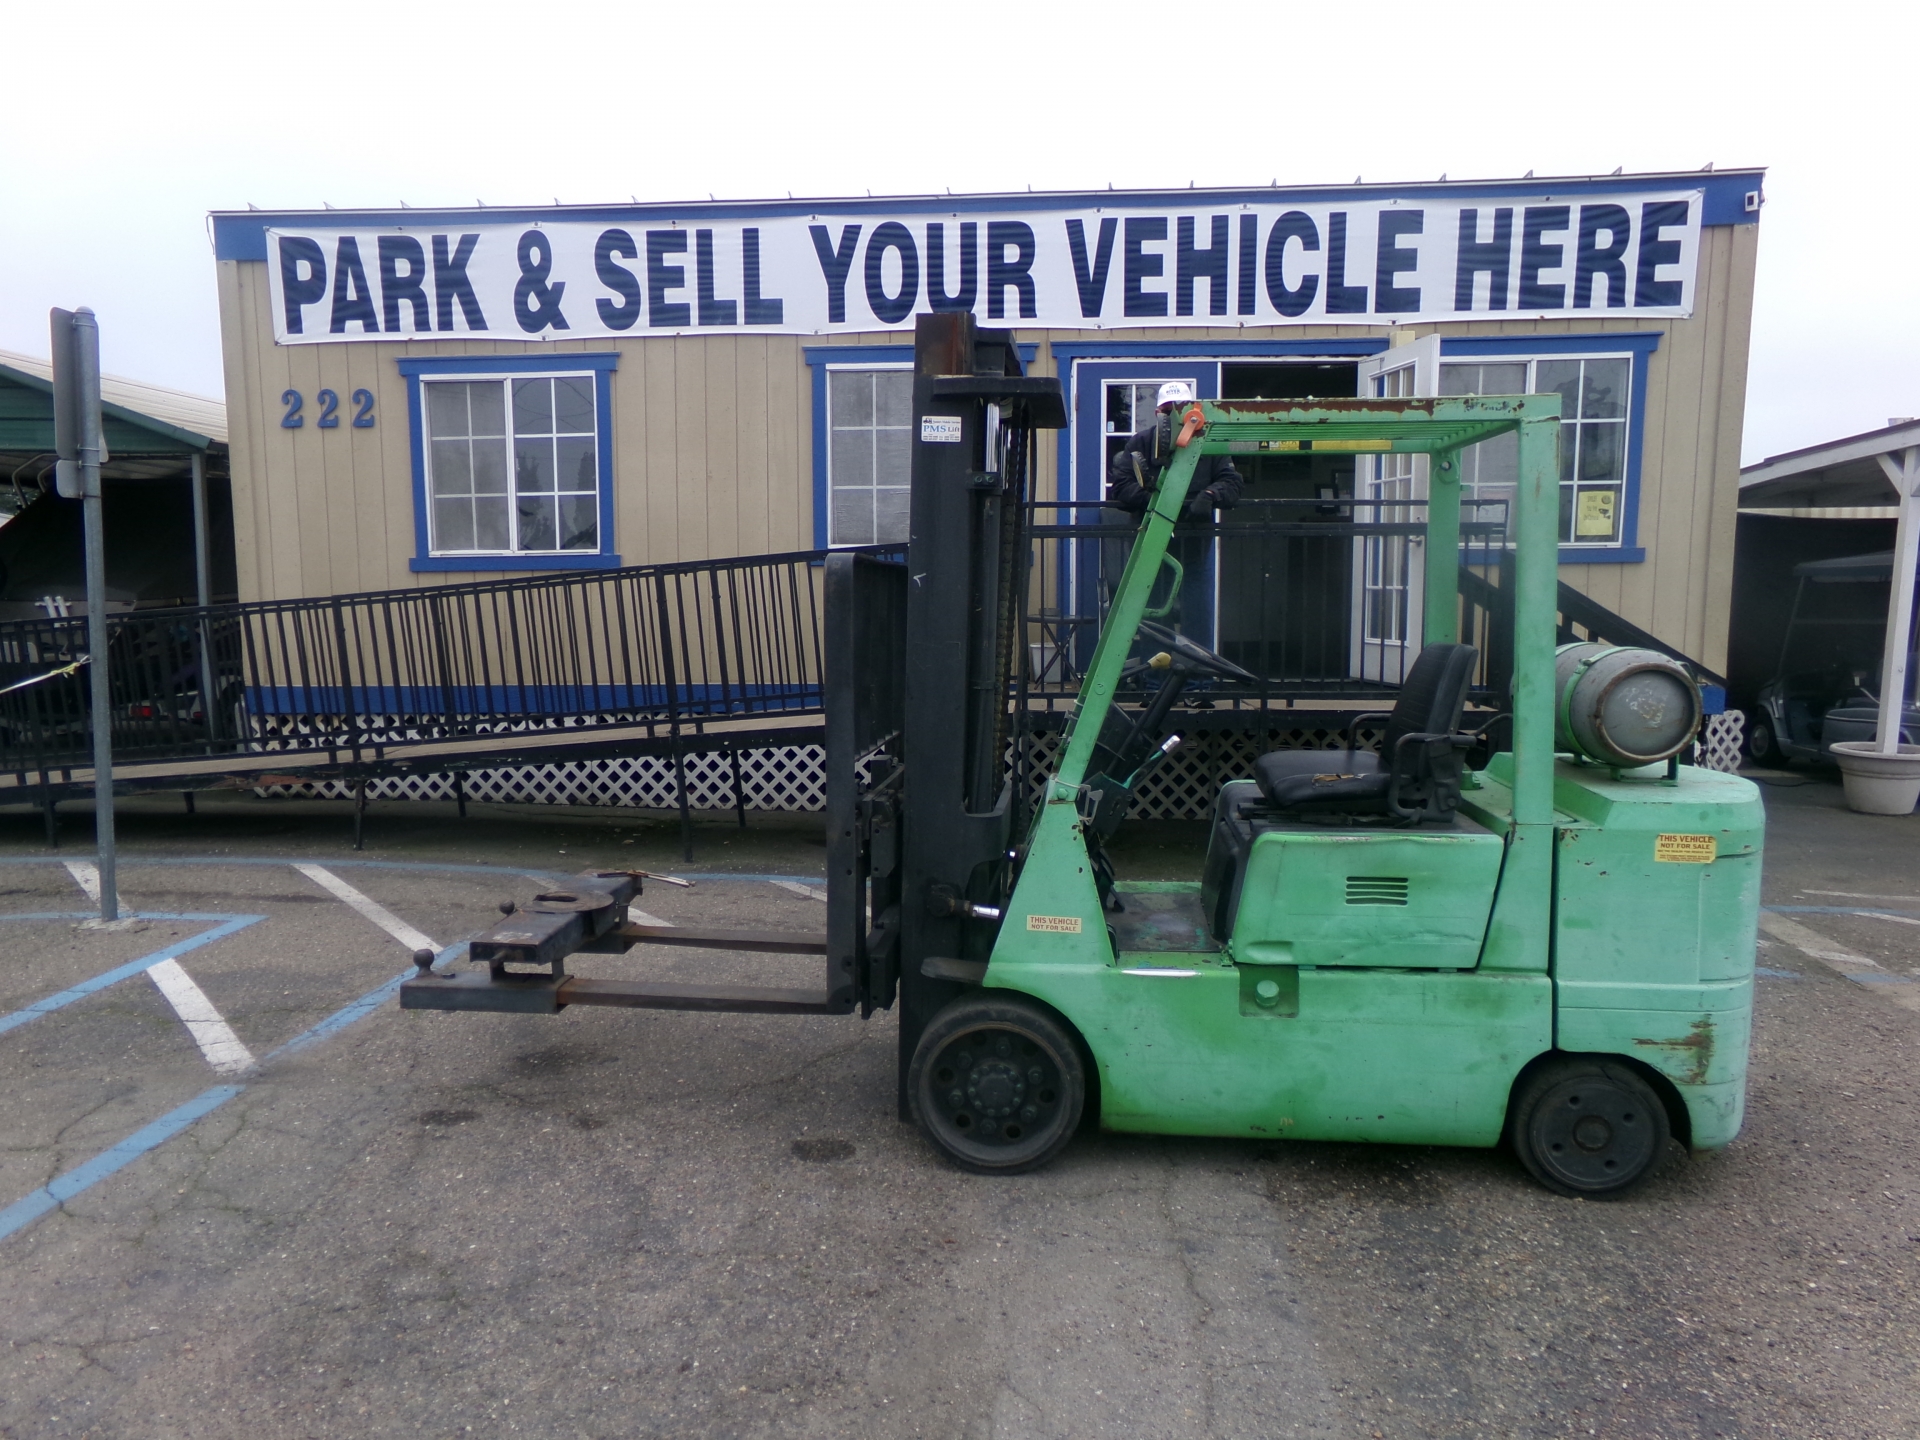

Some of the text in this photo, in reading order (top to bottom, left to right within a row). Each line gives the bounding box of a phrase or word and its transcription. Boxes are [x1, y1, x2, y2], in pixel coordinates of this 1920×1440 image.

[279, 201, 1689, 334] PARK & SELL YOUR VEHICLE HERE
[281, 388, 374, 428] 222
